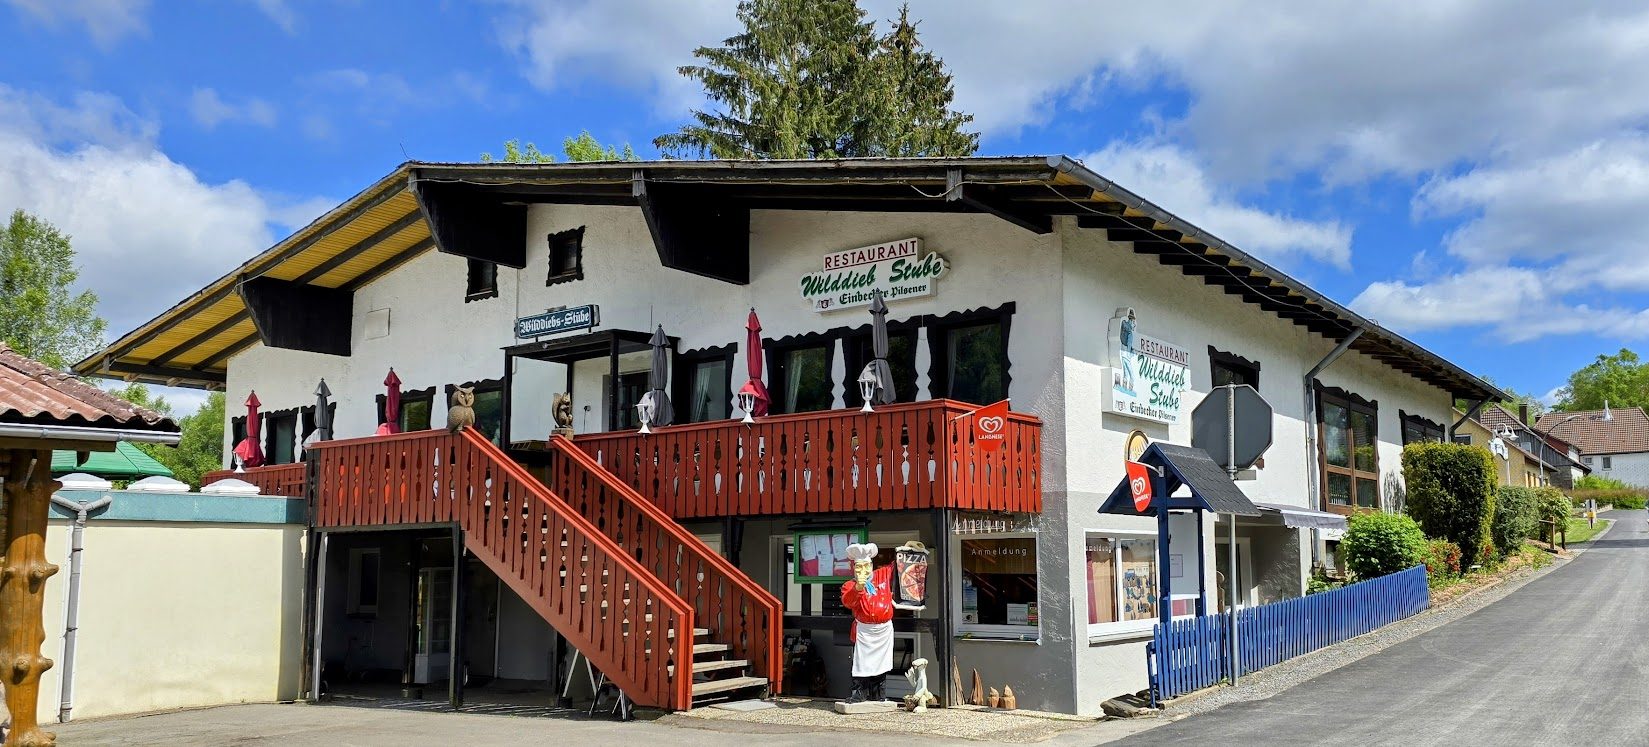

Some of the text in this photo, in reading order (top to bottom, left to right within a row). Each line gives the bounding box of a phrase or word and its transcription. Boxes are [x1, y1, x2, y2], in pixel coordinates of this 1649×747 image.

[825, 240, 916, 268] RESTAURANT
[801, 254, 942, 297] Wilddieb Stube
[890, 284, 927, 298] Pilsener
[1140, 338, 1189, 363] RESTAURANT
[1138, 354, 1185, 387] Wilddieb
[1149, 382, 1180, 410] Stube
[896, 552, 927, 564] PIZZA
[971, 547, 1027, 556] Anmeldung
